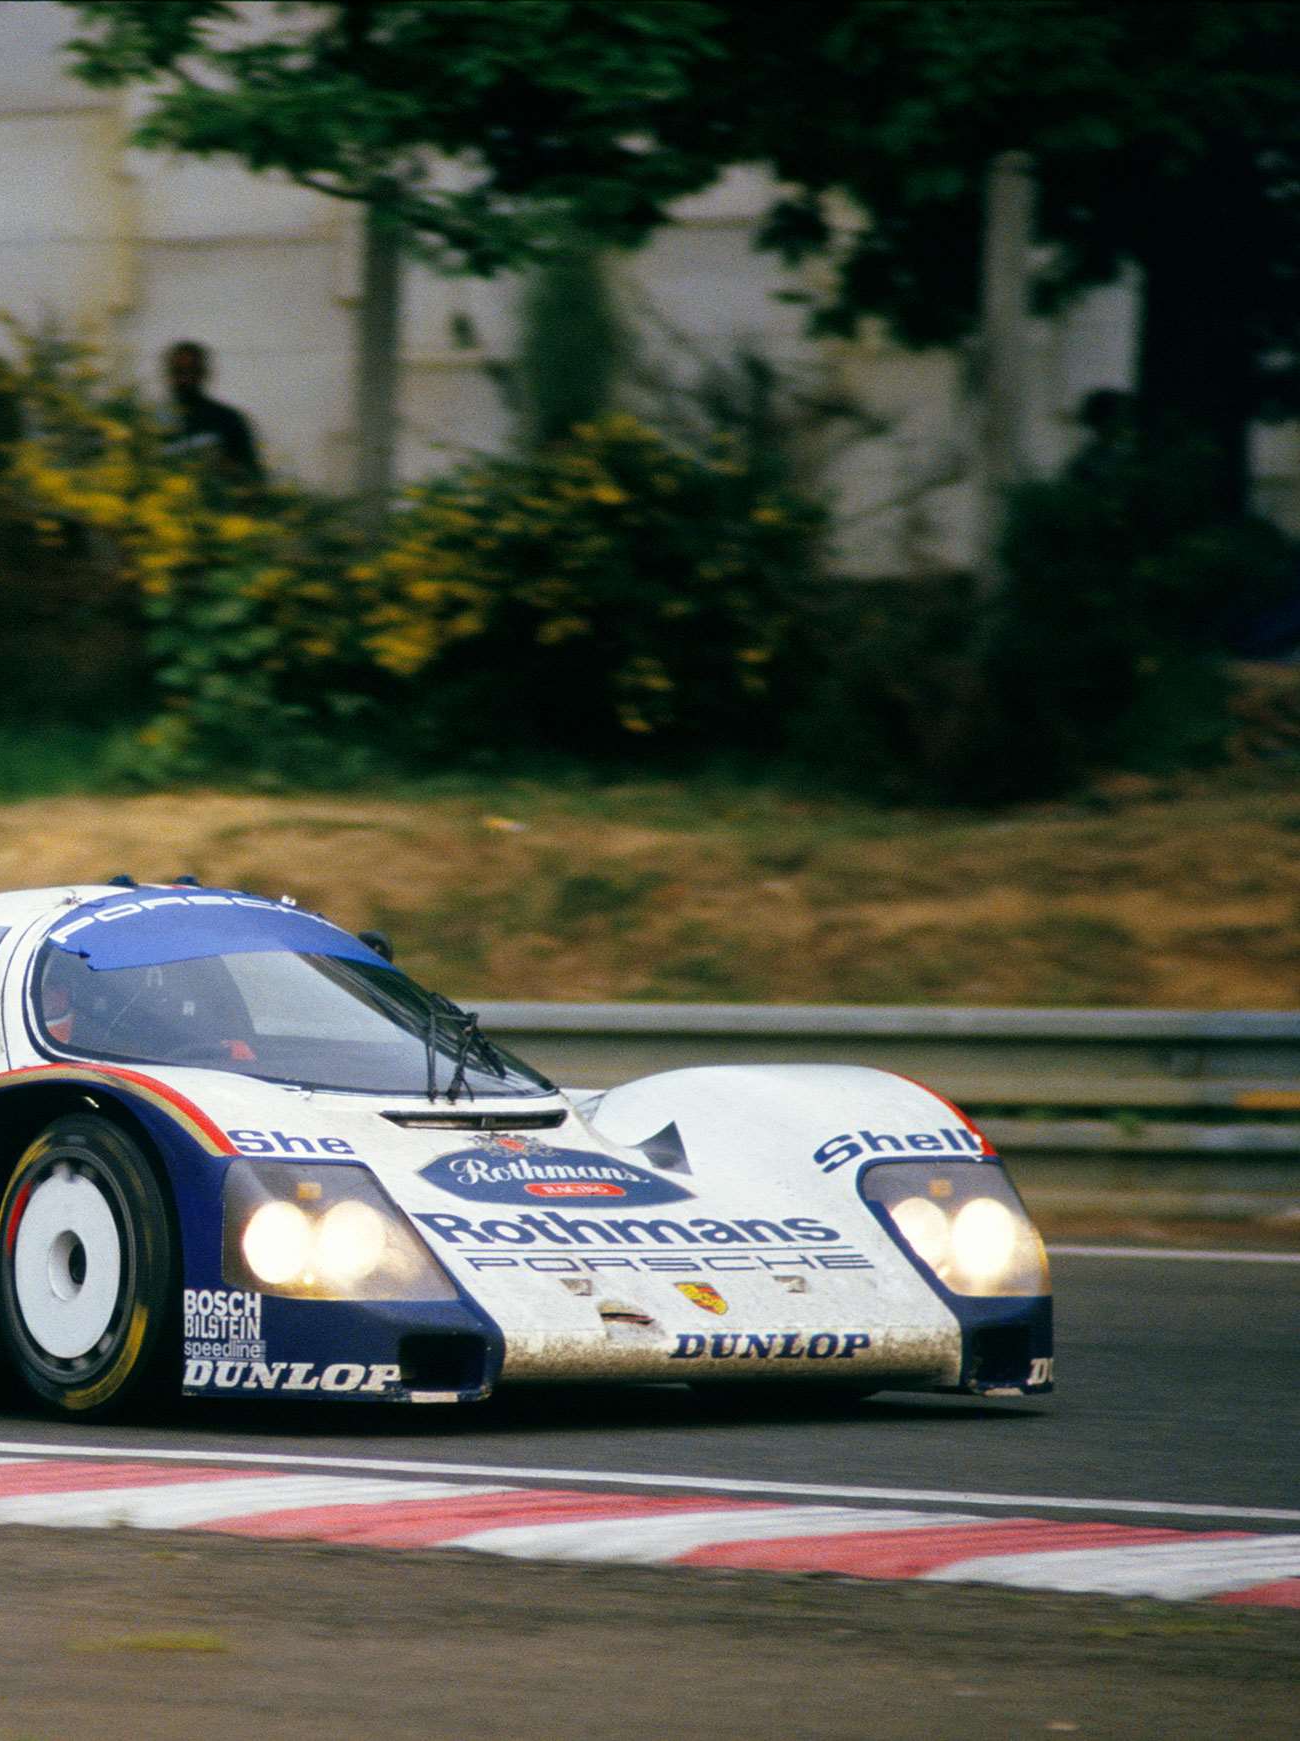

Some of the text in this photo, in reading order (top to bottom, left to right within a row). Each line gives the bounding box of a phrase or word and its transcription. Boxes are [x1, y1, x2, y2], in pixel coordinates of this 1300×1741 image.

[813, 1128, 982, 1174] Shell
[450, 1158, 651, 1185] Rothmans
[411, 1211, 841, 1245] Rothmans
[464, 1254, 876, 1273] PORSCHE
[183, 1289, 262, 1317] BOSCH
[184, 1314, 261, 1340] BILSTEIN
[184, 1341, 262, 1359] speedline
[668, 1333, 871, 1359] DUNLOP
[183, 1359, 402, 1392] DUNLOP
[1027, 1357, 1054, 1386] D
